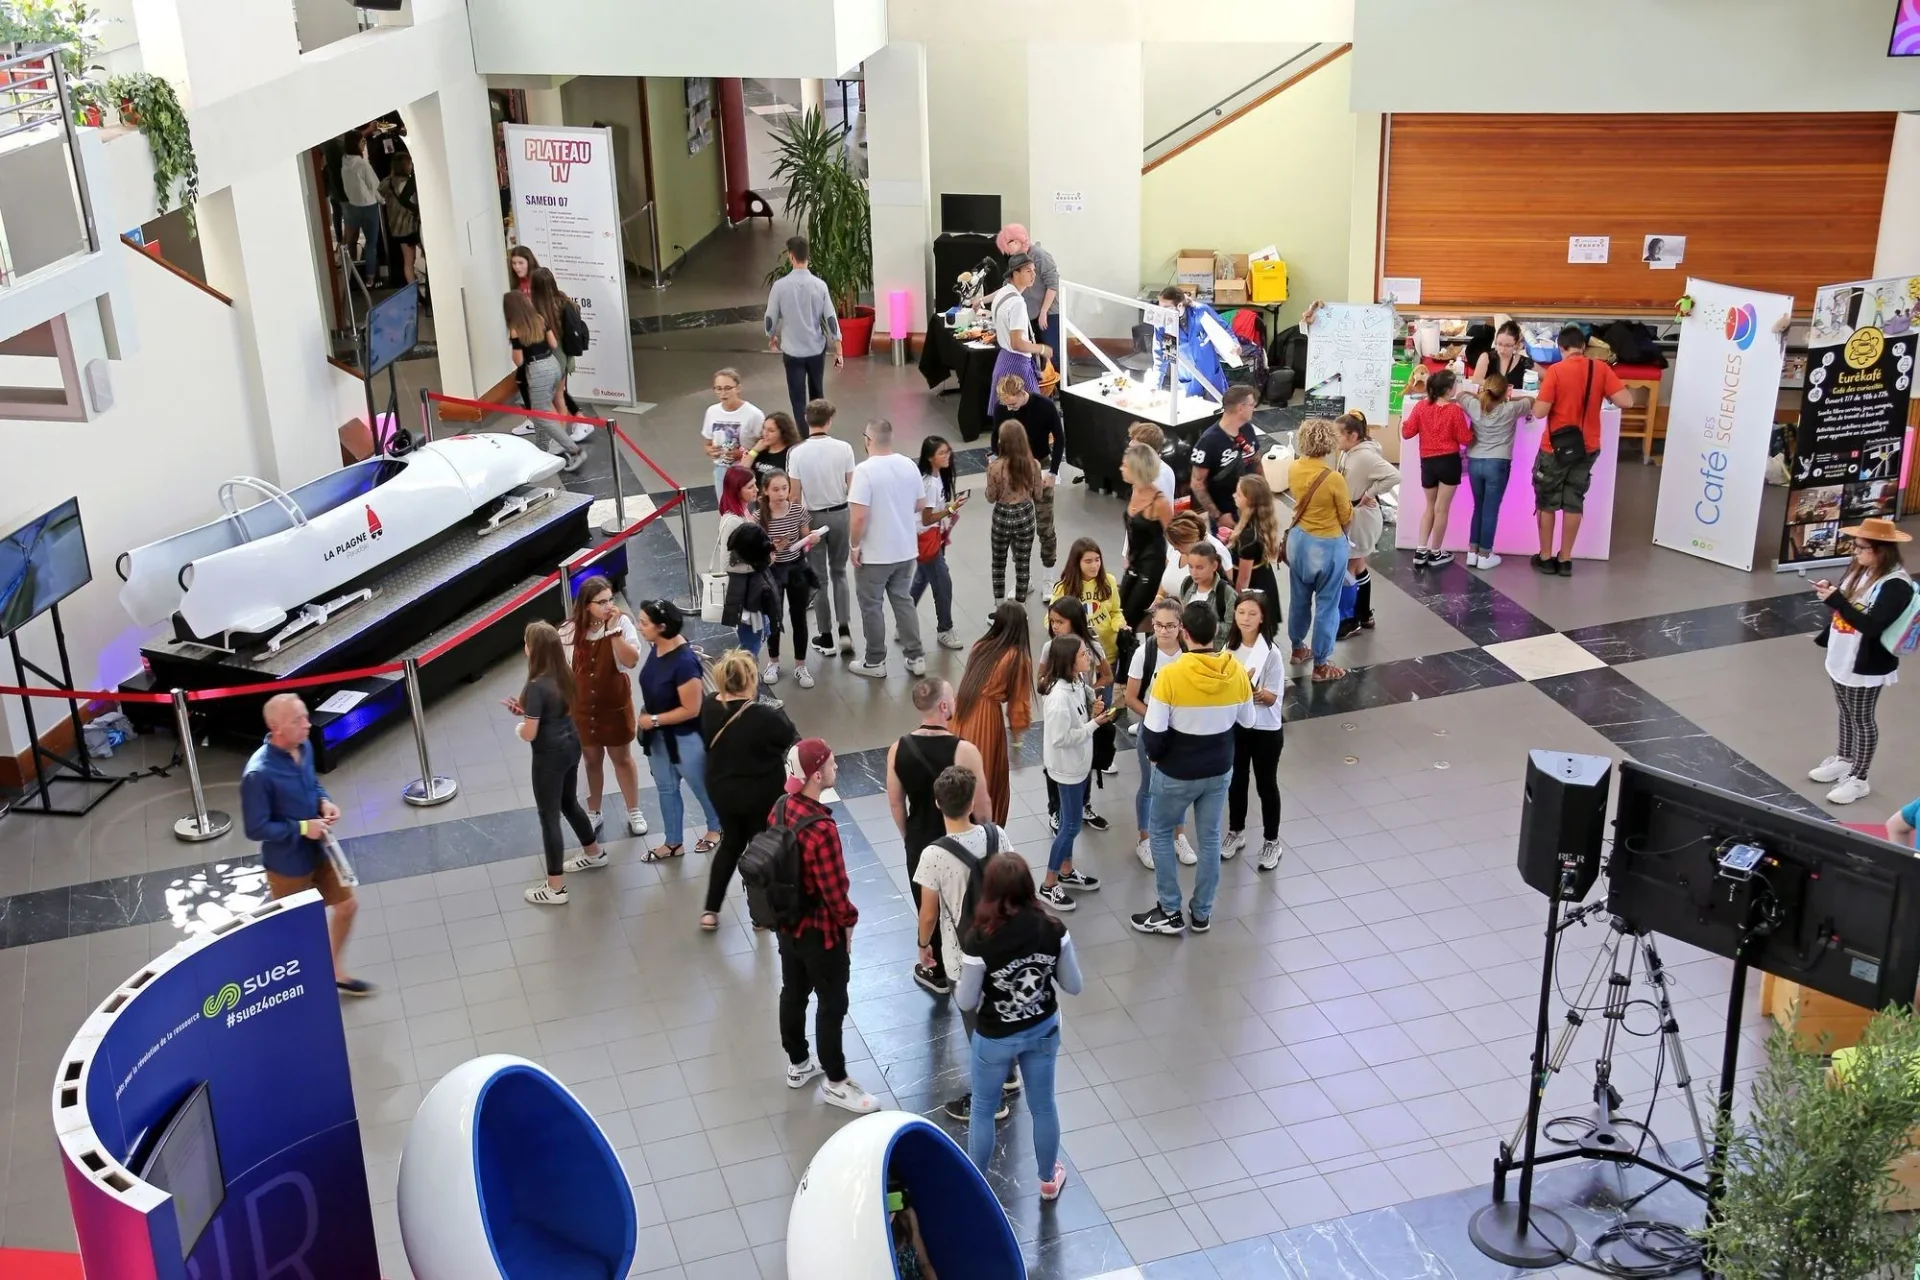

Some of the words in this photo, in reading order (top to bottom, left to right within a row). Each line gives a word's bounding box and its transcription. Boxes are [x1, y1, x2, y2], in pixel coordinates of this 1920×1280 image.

[525, 138, 591, 164] PLATEAU
[550, 162, 570, 182] TV
[526, 195, 556, 206] SAMEDI
[559, 197, 567, 207] 07
[581, 298, 592, 308] 08
[1717, 354, 1742, 443] SCIENCES
[1832, 386, 1845, 394] Café
[1704, 416, 1716, 439] DES
[1695, 451, 1728, 525] Café
[324, 550, 335, 561] LA
[336, 532, 367, 555] PLAGNE
[243, 959, 300, 996] suez
[226, 984, 304, 1028] #suez4ocean
[132, 1066, 138, 1074] la
[138, 1043, 160, 1069] révolution
[160, 1038, 166, 1046] de
[167, 1032, 173, 1040] la
[173, 1012, 200, 1036] ressource
